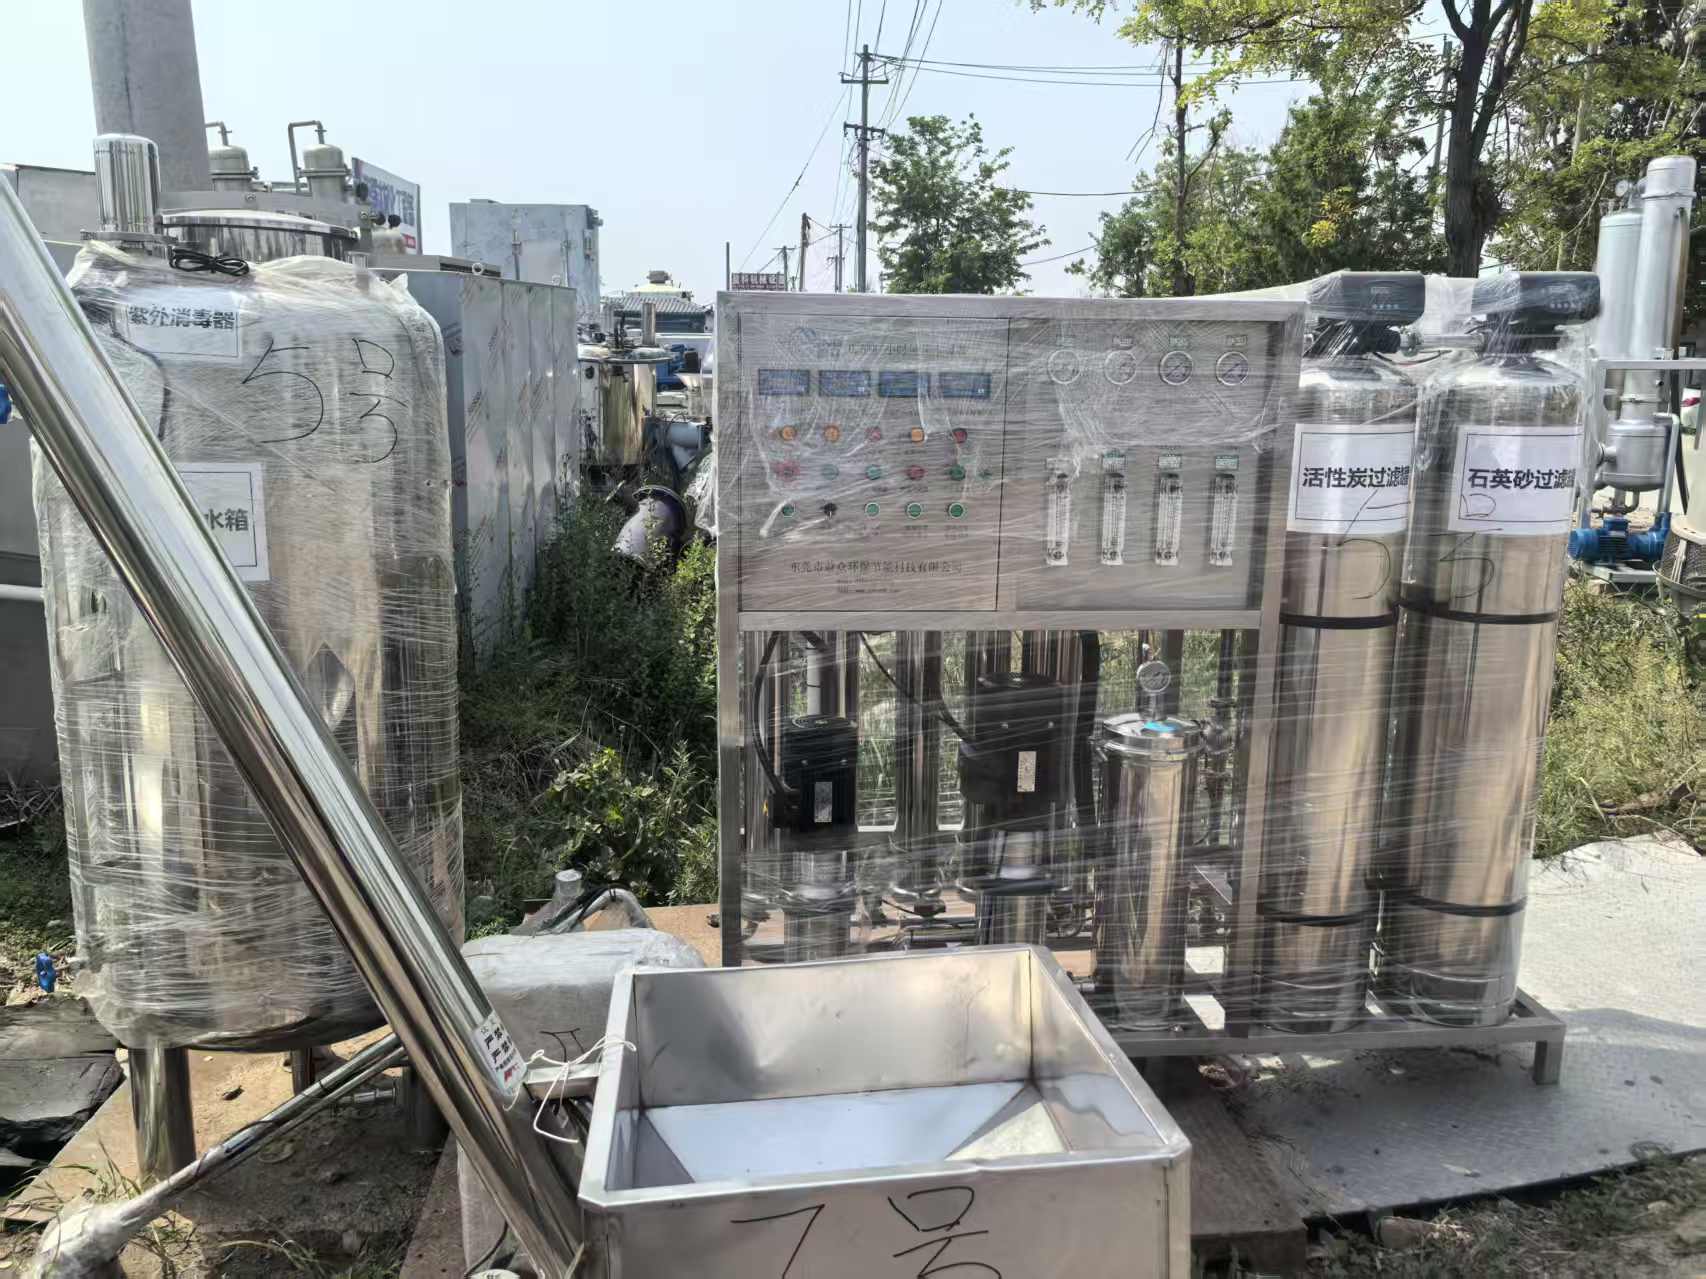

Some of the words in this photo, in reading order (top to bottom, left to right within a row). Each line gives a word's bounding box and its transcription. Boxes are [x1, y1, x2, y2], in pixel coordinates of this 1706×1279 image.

[128, 304, 235, 329] 紫外消毒器
